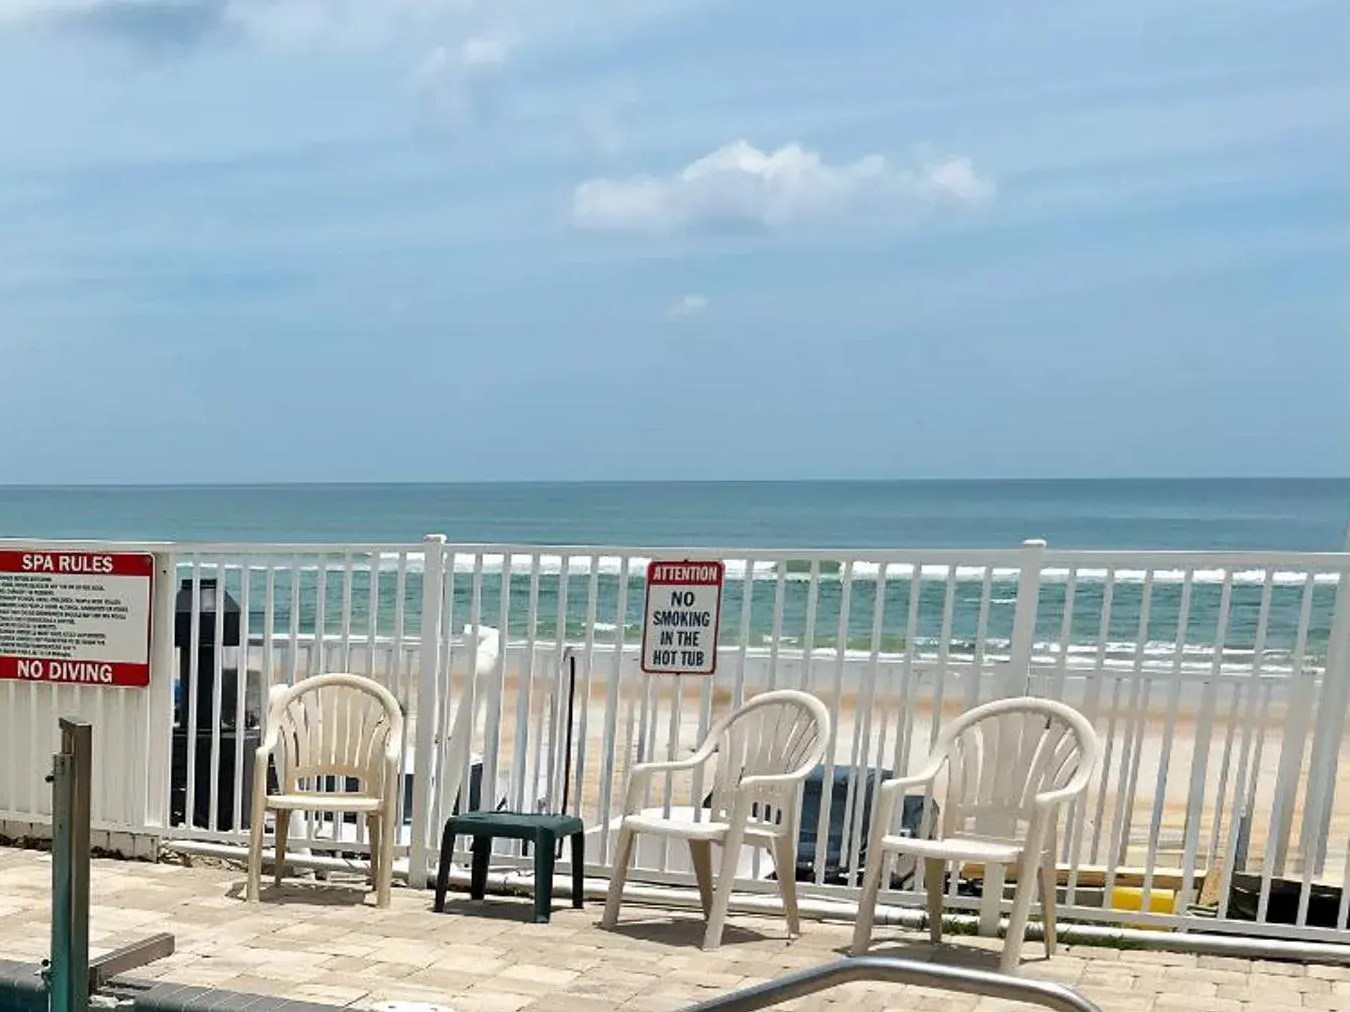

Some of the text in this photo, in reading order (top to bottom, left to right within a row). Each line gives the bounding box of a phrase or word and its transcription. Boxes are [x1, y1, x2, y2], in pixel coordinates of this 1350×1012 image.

[22, 554, 113, 573] SPA RULES
[653, 565, 717, 581] ATTENTION
[670, 591, 695, 607] NO
[653, 611, 710, 627] SMOKING
[660, 631, 699, 646] IN THE
[652, 650, 704, 666] HOT TUB
[17, 660, 113, 683] NO DIVING
